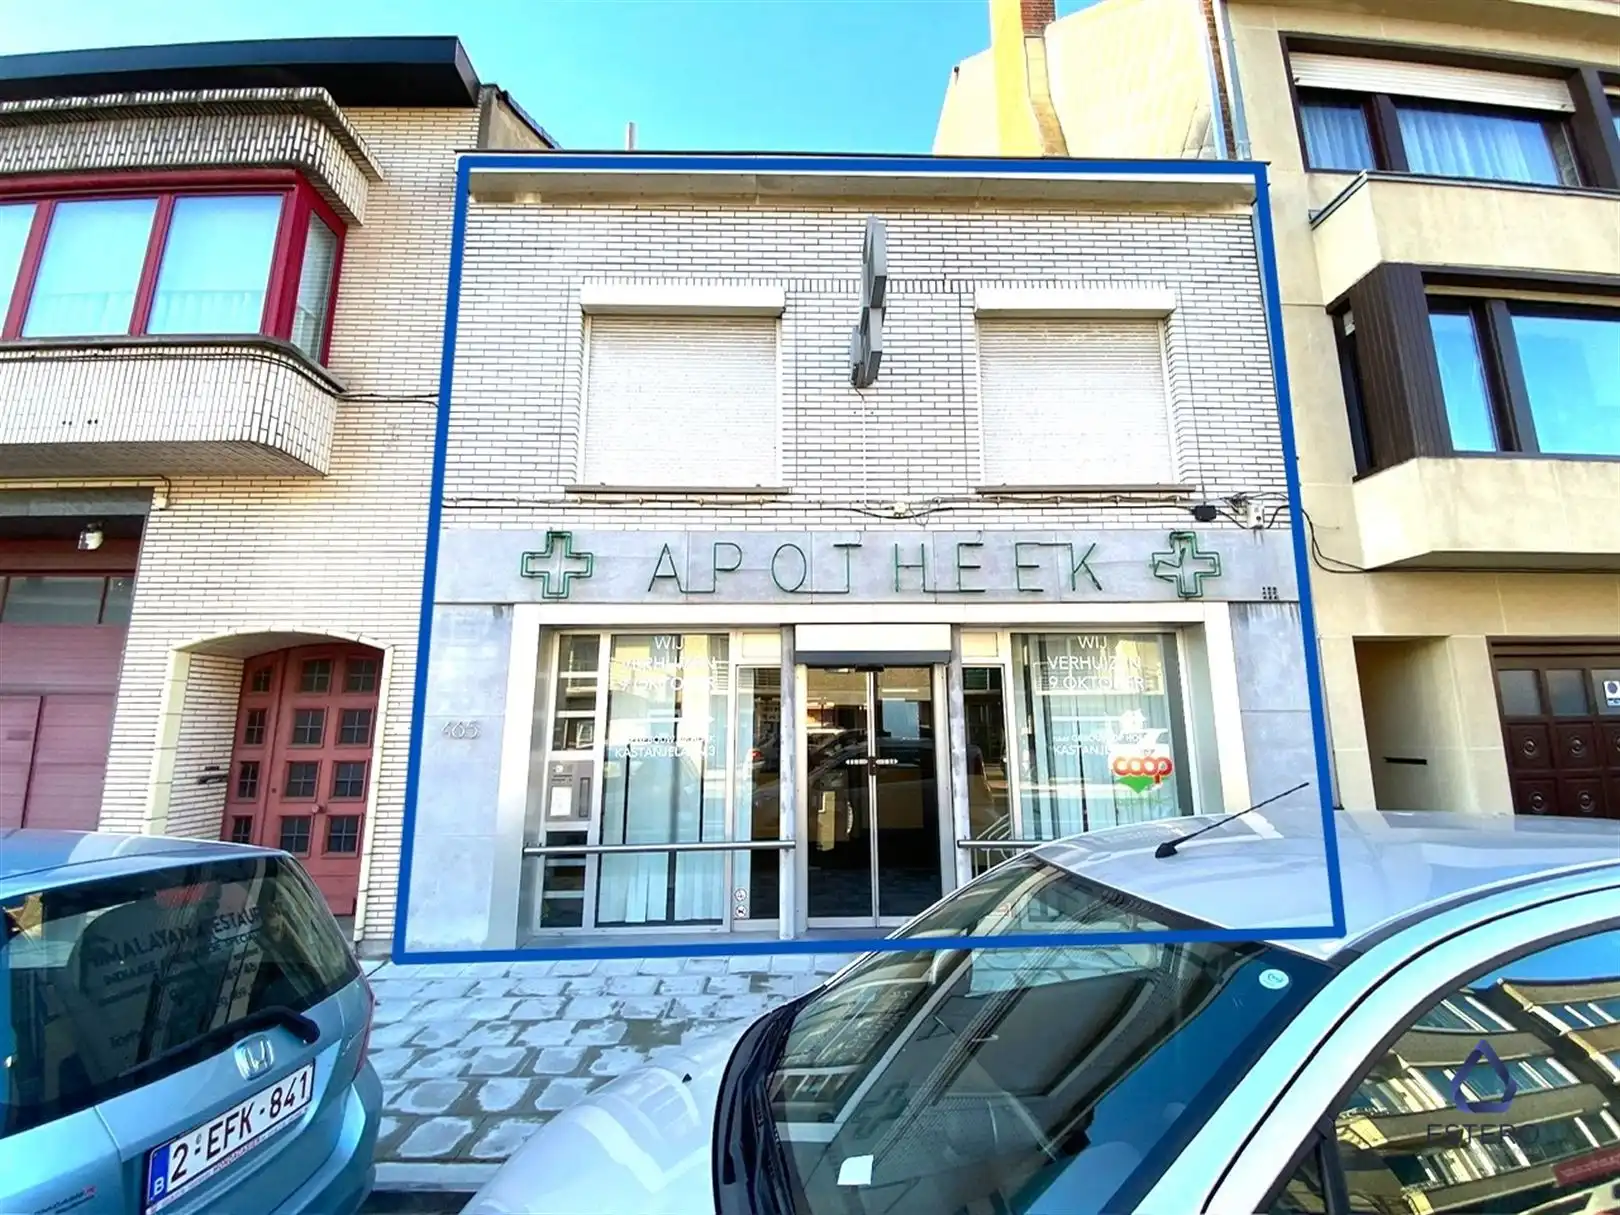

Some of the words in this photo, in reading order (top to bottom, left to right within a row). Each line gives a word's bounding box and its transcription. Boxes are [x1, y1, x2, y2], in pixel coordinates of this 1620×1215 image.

[648, 542, 1103, 593] APOTHEEK
[654, 635, 685, 650] WIJ
[1077, 635, 1108, 649] WIJ
[1047, 655, 1141, 670] VERHUIZN
[1113, 756, 1173, 785] coop
[153, 1176, 165, 1195] B
